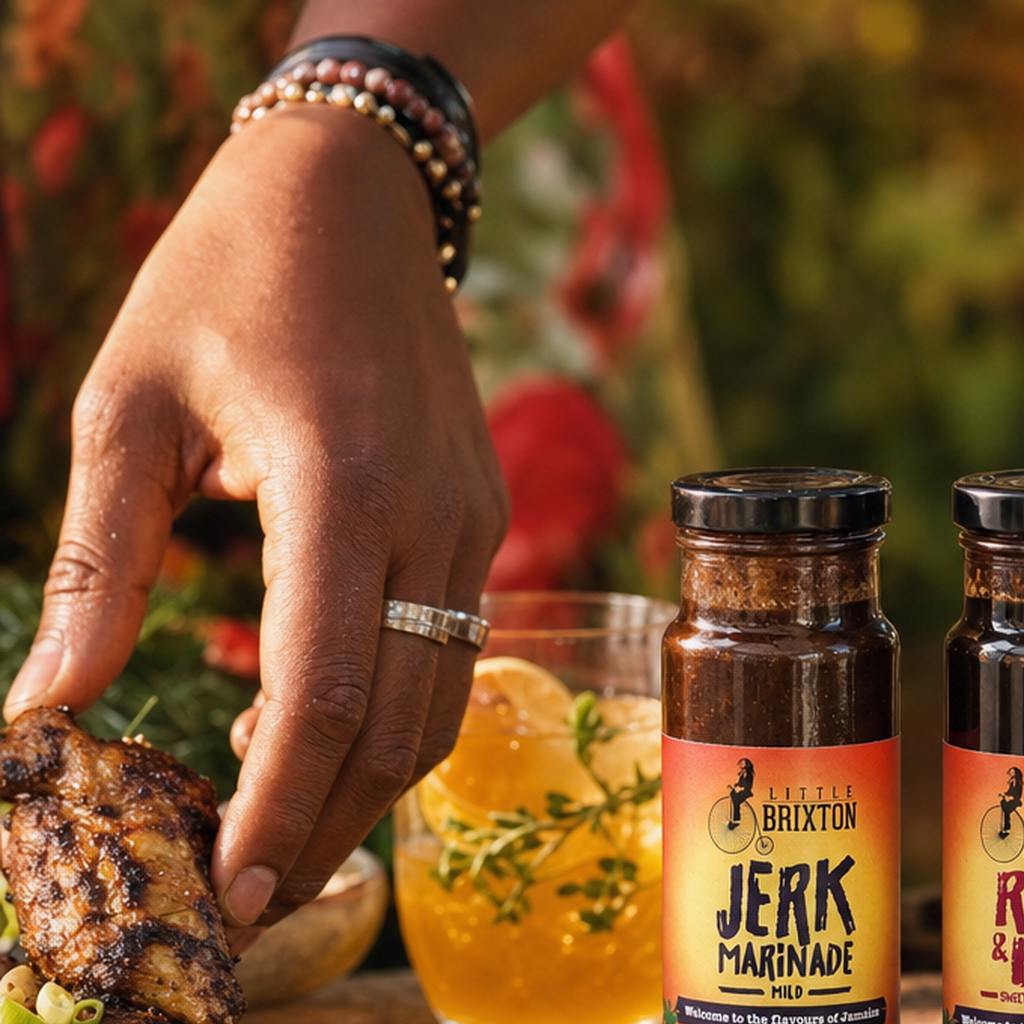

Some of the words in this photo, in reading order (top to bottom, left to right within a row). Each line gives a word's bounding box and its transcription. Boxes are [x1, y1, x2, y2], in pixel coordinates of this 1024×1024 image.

[769, 785, 854, 800] LITTLE
[762, 801, 857, 832] BRIXTON
[716, 855, 856, 947] JERK
[771, 985, 803, 999] MILD
[684, 1005, 729, 1023] Welcome
[732, 1012, 745, 1024] to
[747, 1013, 768, 1024] the
[827, 1012, 838, 1023] of
